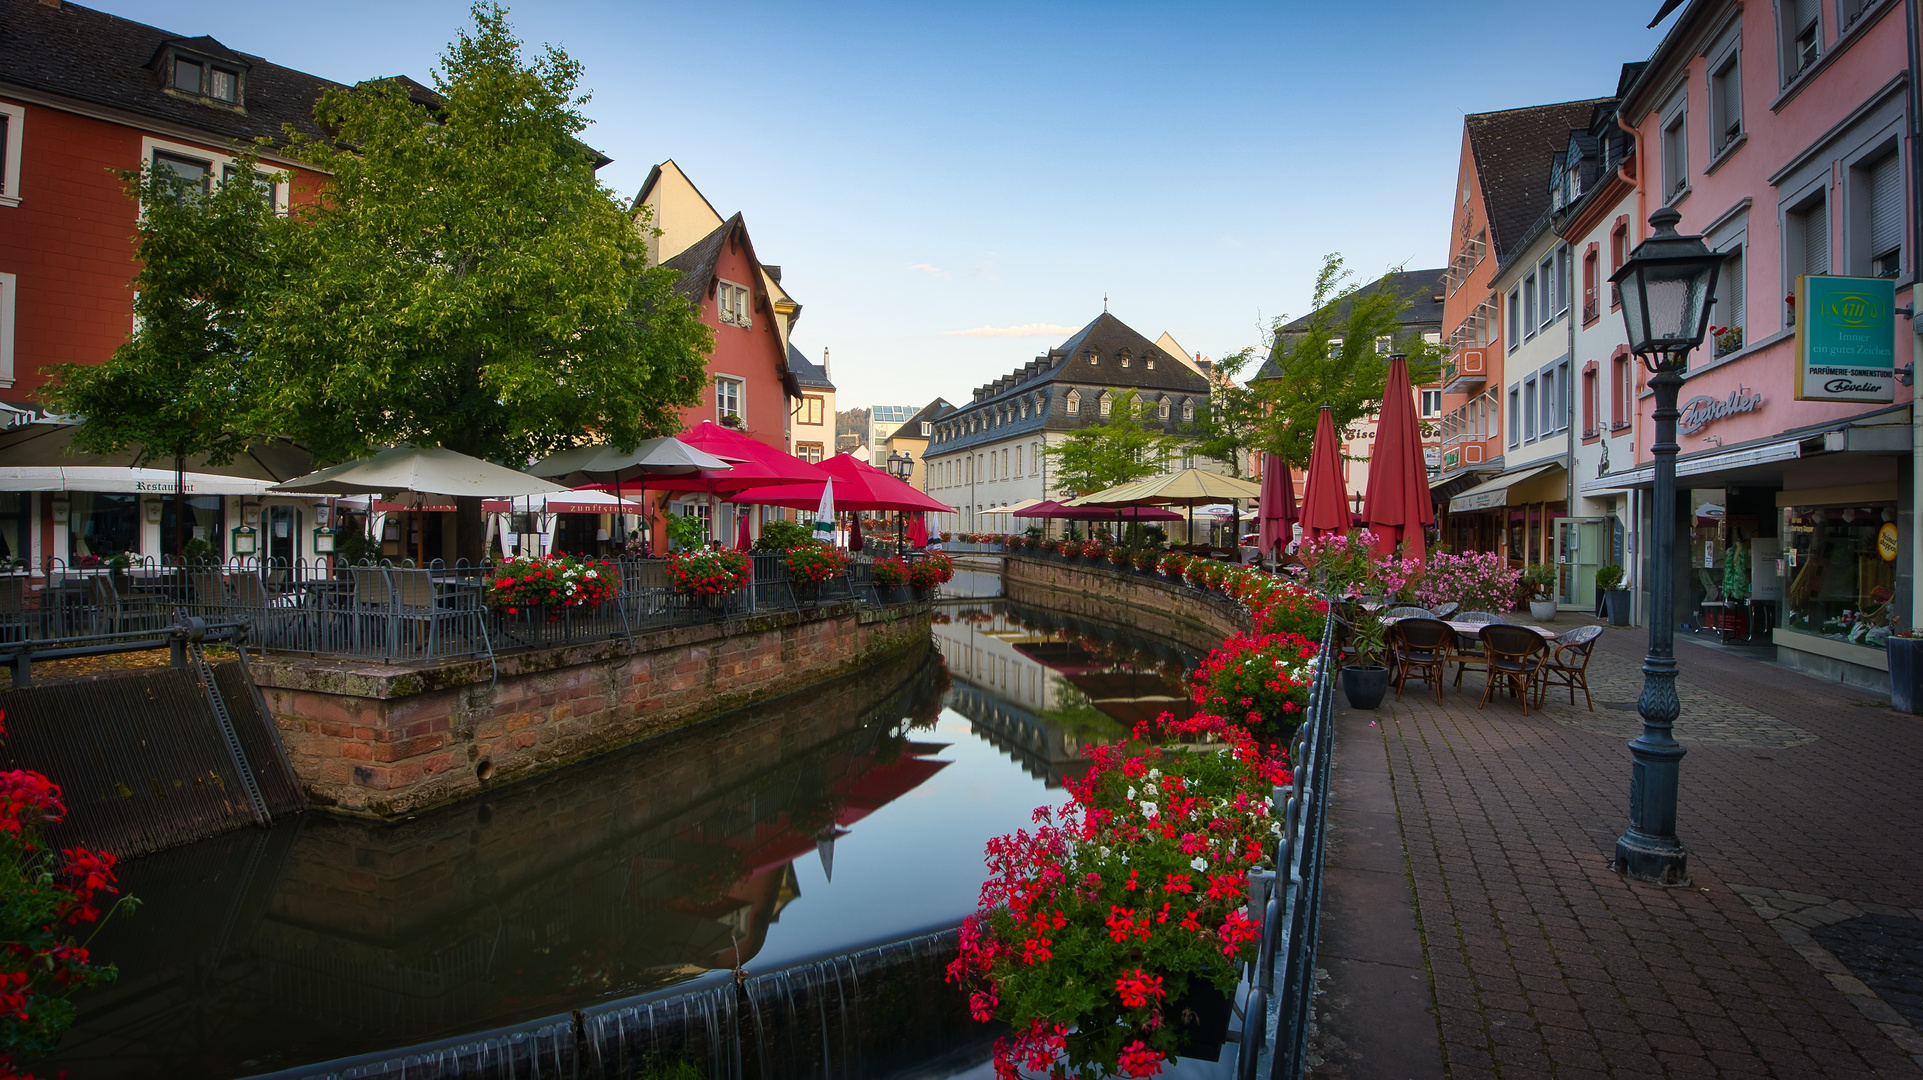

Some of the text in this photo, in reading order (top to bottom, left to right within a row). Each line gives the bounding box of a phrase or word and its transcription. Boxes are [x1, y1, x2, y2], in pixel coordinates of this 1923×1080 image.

[1841, 303, 1865, 317] 4711
[1839, 332, 1870, 342] Immer
[1813, 344, 1891, 357] ein gutes Zeichen
[1824, 378, 1882, 393] Chevalier
[1677, 391, 1761, 435] Chevalier
[1343, 428, 1375, 440] Eisc
[136, 481, 194, 492] Restaurnt
[570, 504, 633, 513] zunftstube
